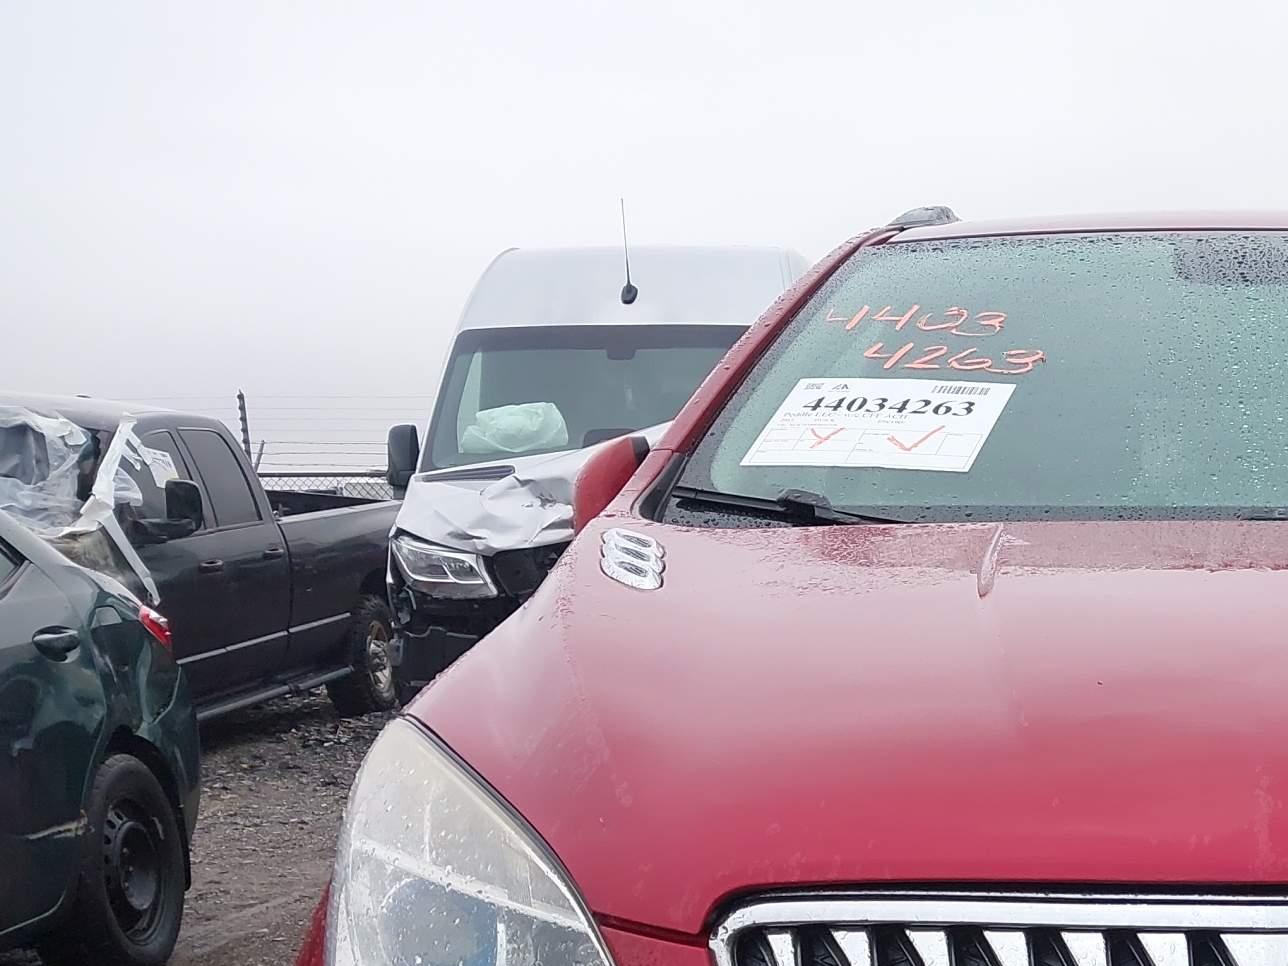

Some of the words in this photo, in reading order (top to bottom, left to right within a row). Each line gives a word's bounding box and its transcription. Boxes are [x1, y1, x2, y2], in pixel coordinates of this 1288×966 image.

[826, 304, 1008, 337] 4403
[863, 341, 1046, 375] 4263
[803, 396, 976, 417] 44034263
